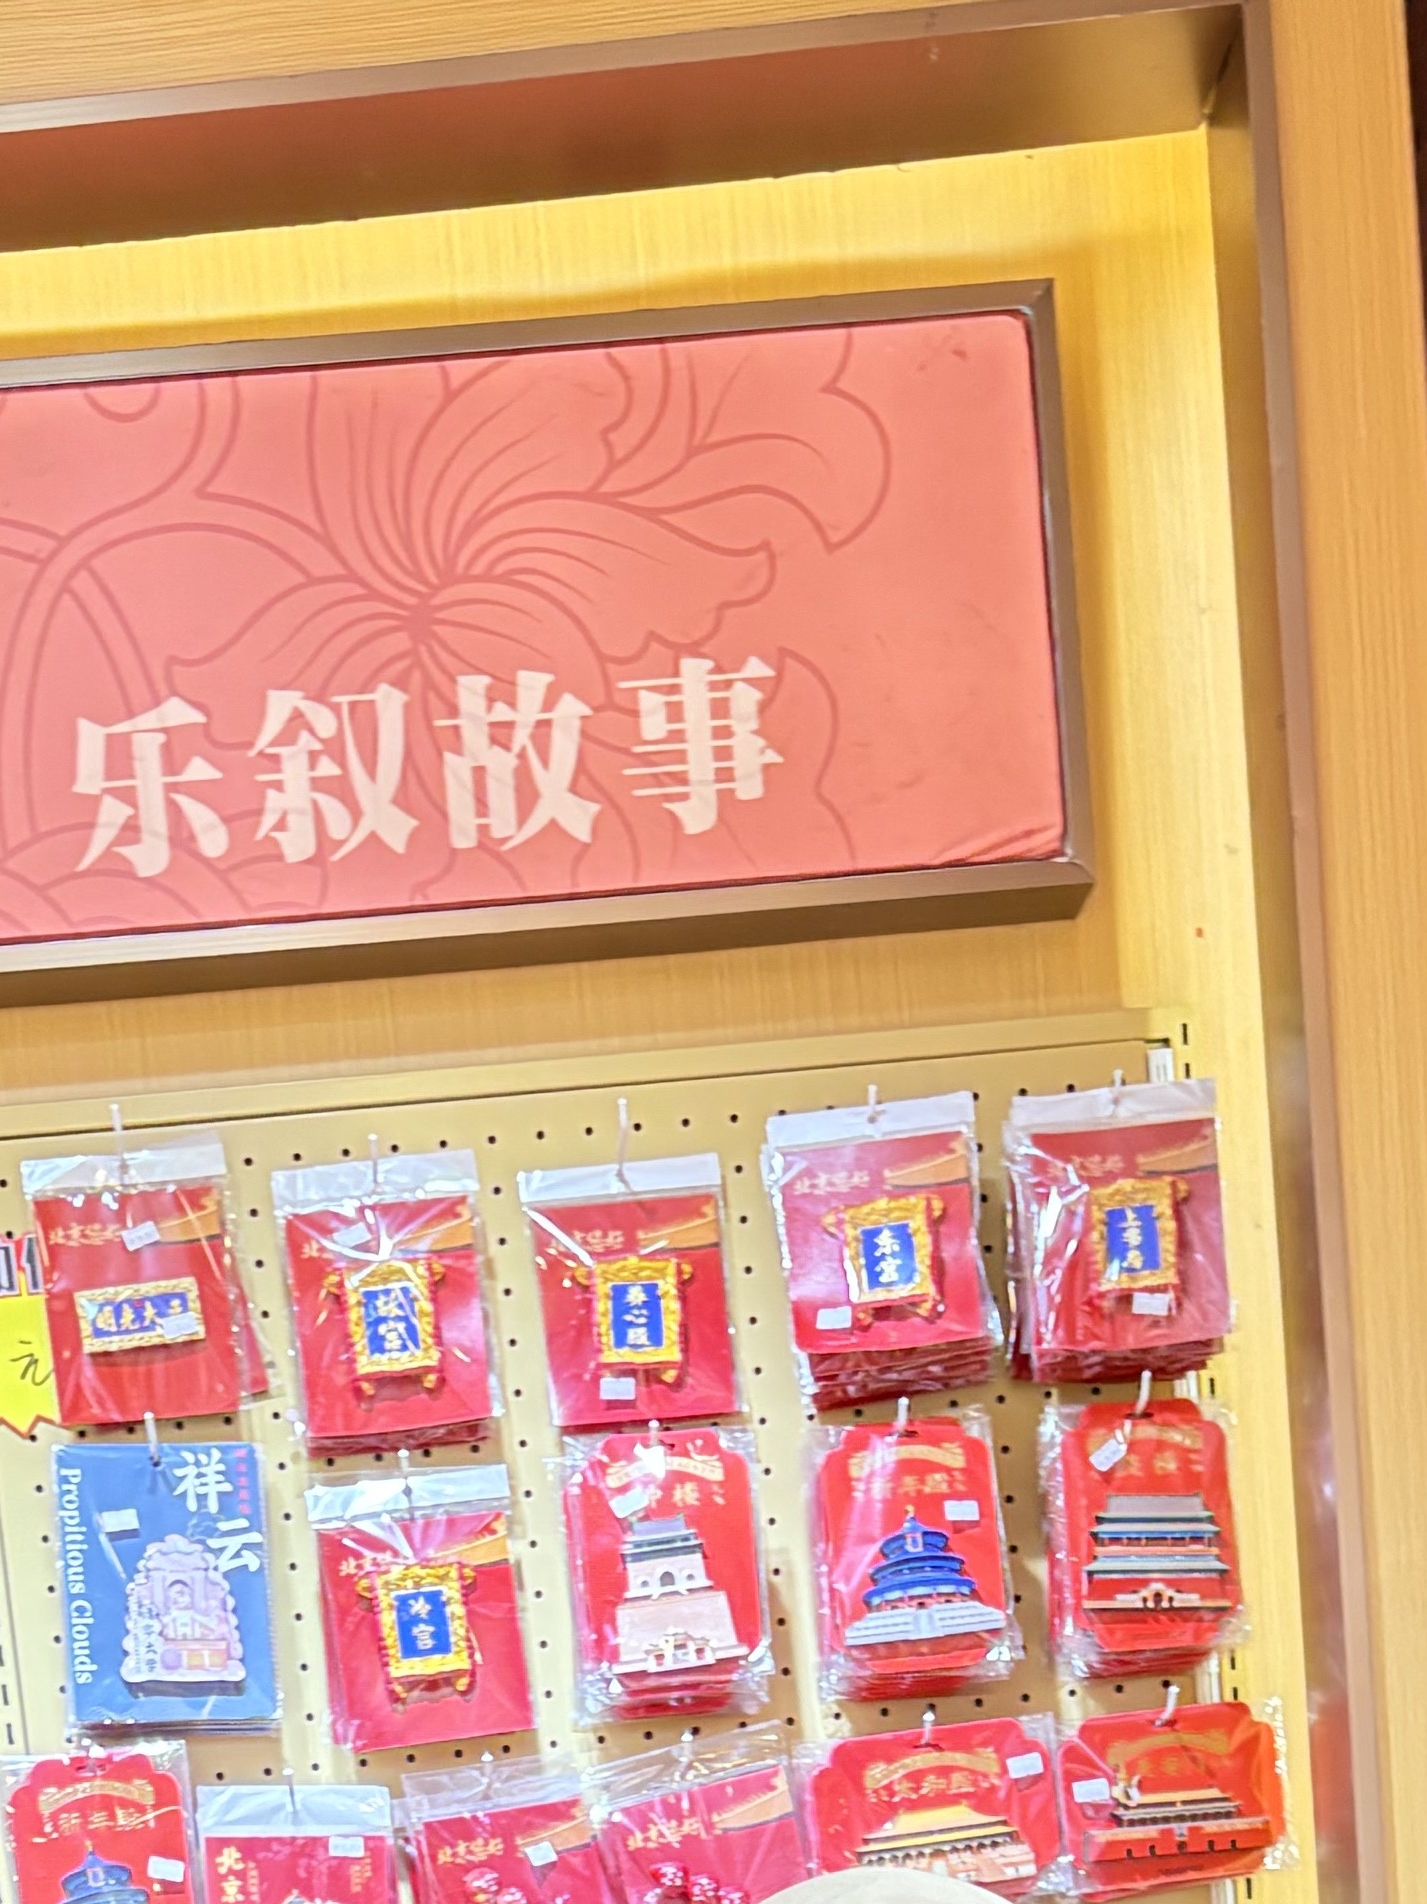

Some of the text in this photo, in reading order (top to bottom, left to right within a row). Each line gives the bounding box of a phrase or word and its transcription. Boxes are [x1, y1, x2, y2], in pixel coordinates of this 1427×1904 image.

[73, 656, 784, 878] 乐叙故事
[58, 1468, 98, 1684] Propitious Clouds
[173, 1448, 263, 1574] 祥云
[215, 1846, 245, 1904] 北京
